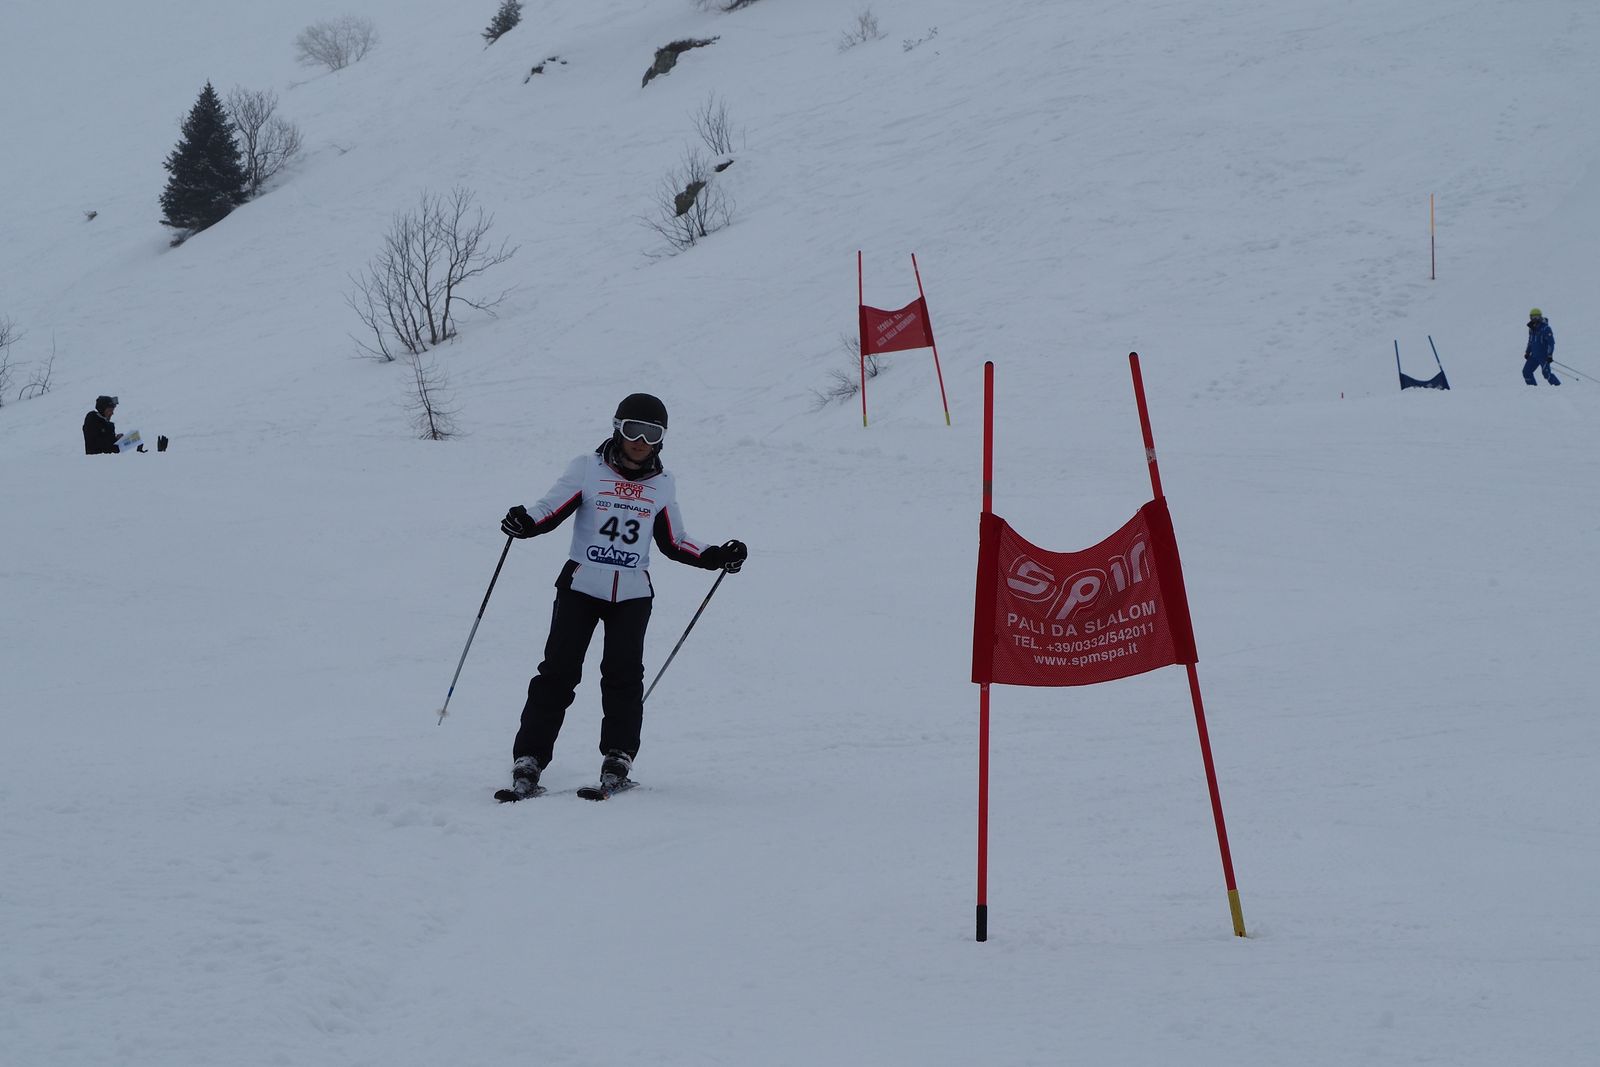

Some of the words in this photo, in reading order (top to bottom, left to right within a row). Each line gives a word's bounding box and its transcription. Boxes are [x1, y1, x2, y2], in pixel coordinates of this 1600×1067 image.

[613, 503, 651, 514] BONALDI
[599, 516, 640, 545] 43
[1007, 612, 1045, 635] PALI
[1051, 624, 1078, 637] DA
[1084, 600, 1156, 634] SLALOM
[1013, 634, 1043, 650] TEL.
[1046, 622, 1154, 653] +39/0332/542011
[1034, 642, 1139, 667] www.spmspa.it
